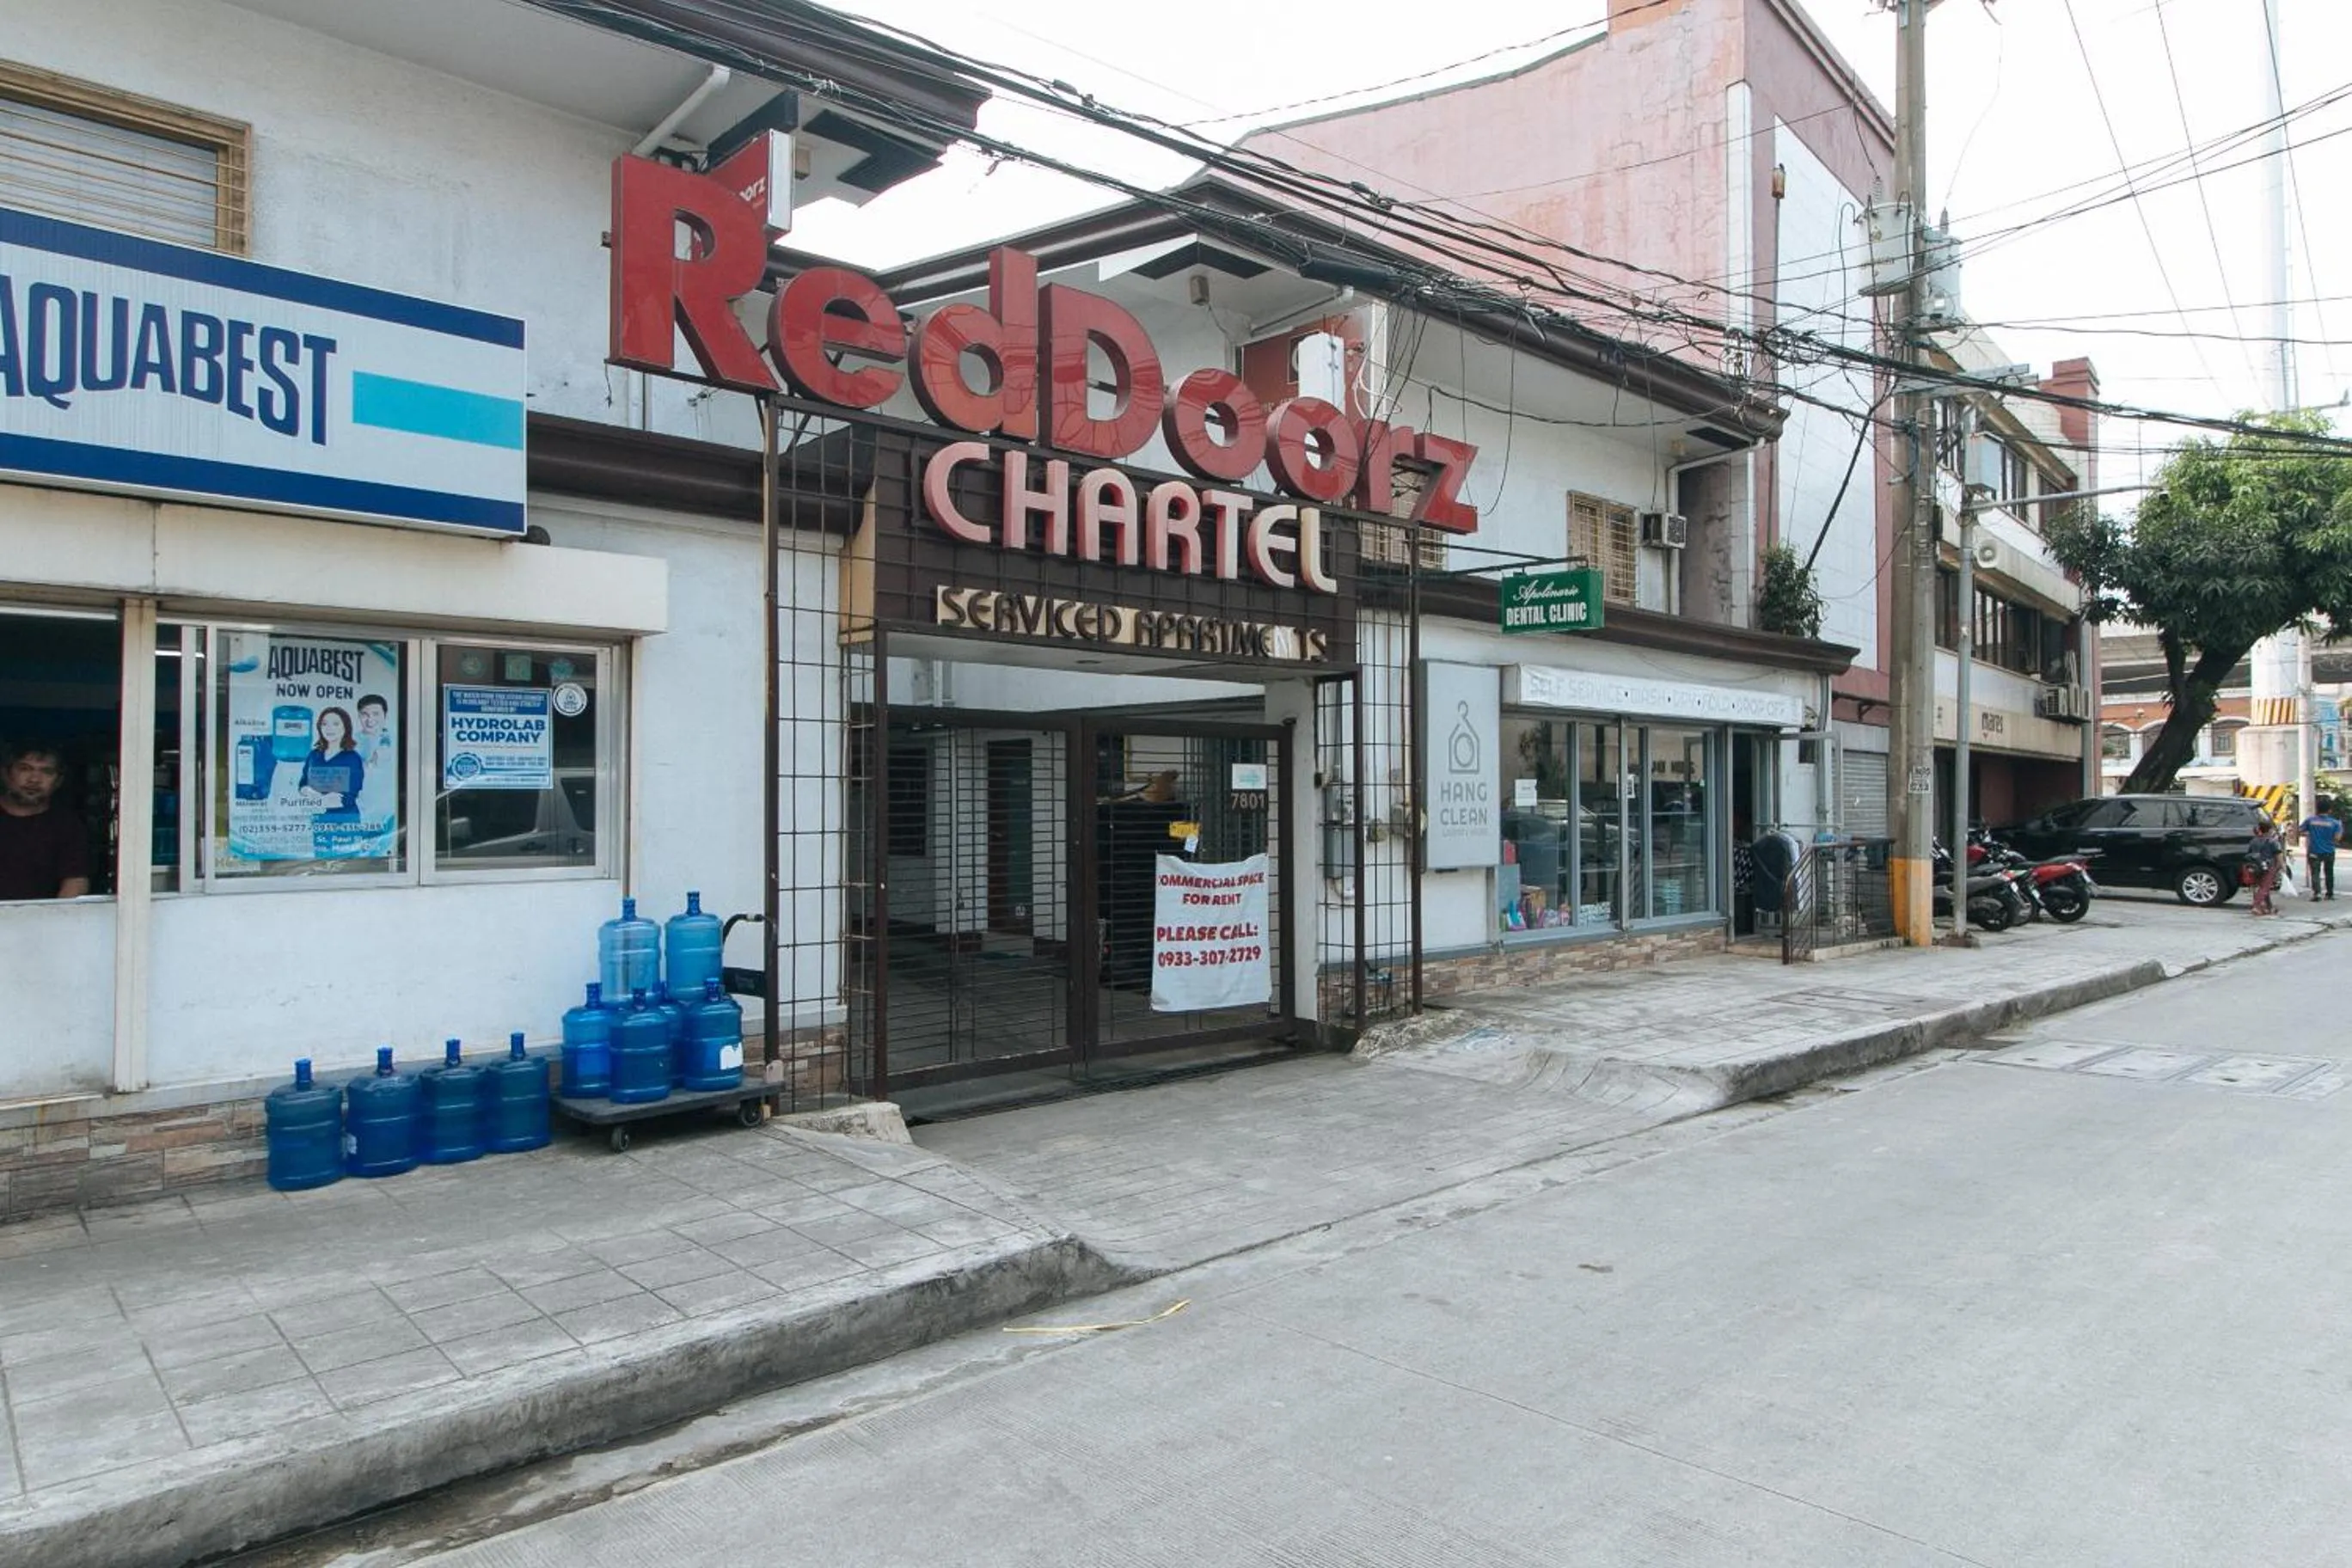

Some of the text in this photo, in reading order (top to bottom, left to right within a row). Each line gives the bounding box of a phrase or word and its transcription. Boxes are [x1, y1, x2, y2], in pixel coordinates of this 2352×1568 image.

[609, 152, 1479, 536] RedDoorz
[0, 274, 337, 446] AQUABEST
[923, 441, 1338, 593] CHARTEL
[941, 587, 1122, 643] SERVICED
[1506, 602, 1587, 626] DENTAL CLINIC
[266, 645, 364, 684] AQUABEST
[276, 683, 353, 699] NOW OPEN
[451, 717, 545, 731] HYDROLAB
[456, 730, 541, 744] COMPANY
[1441, 781, 1487, 802] HANG
[279, 798, 322, 807] Purified
[1231, 793, 1265, 810] 7801
[1440, 808, 1487, 825] CLEAN
[1238, 872, 1265, 885] SPACE
[1183, 893, 1241, 905] FOR RENT
[1156, 922, 1258, 942] PLEASE CALL:
